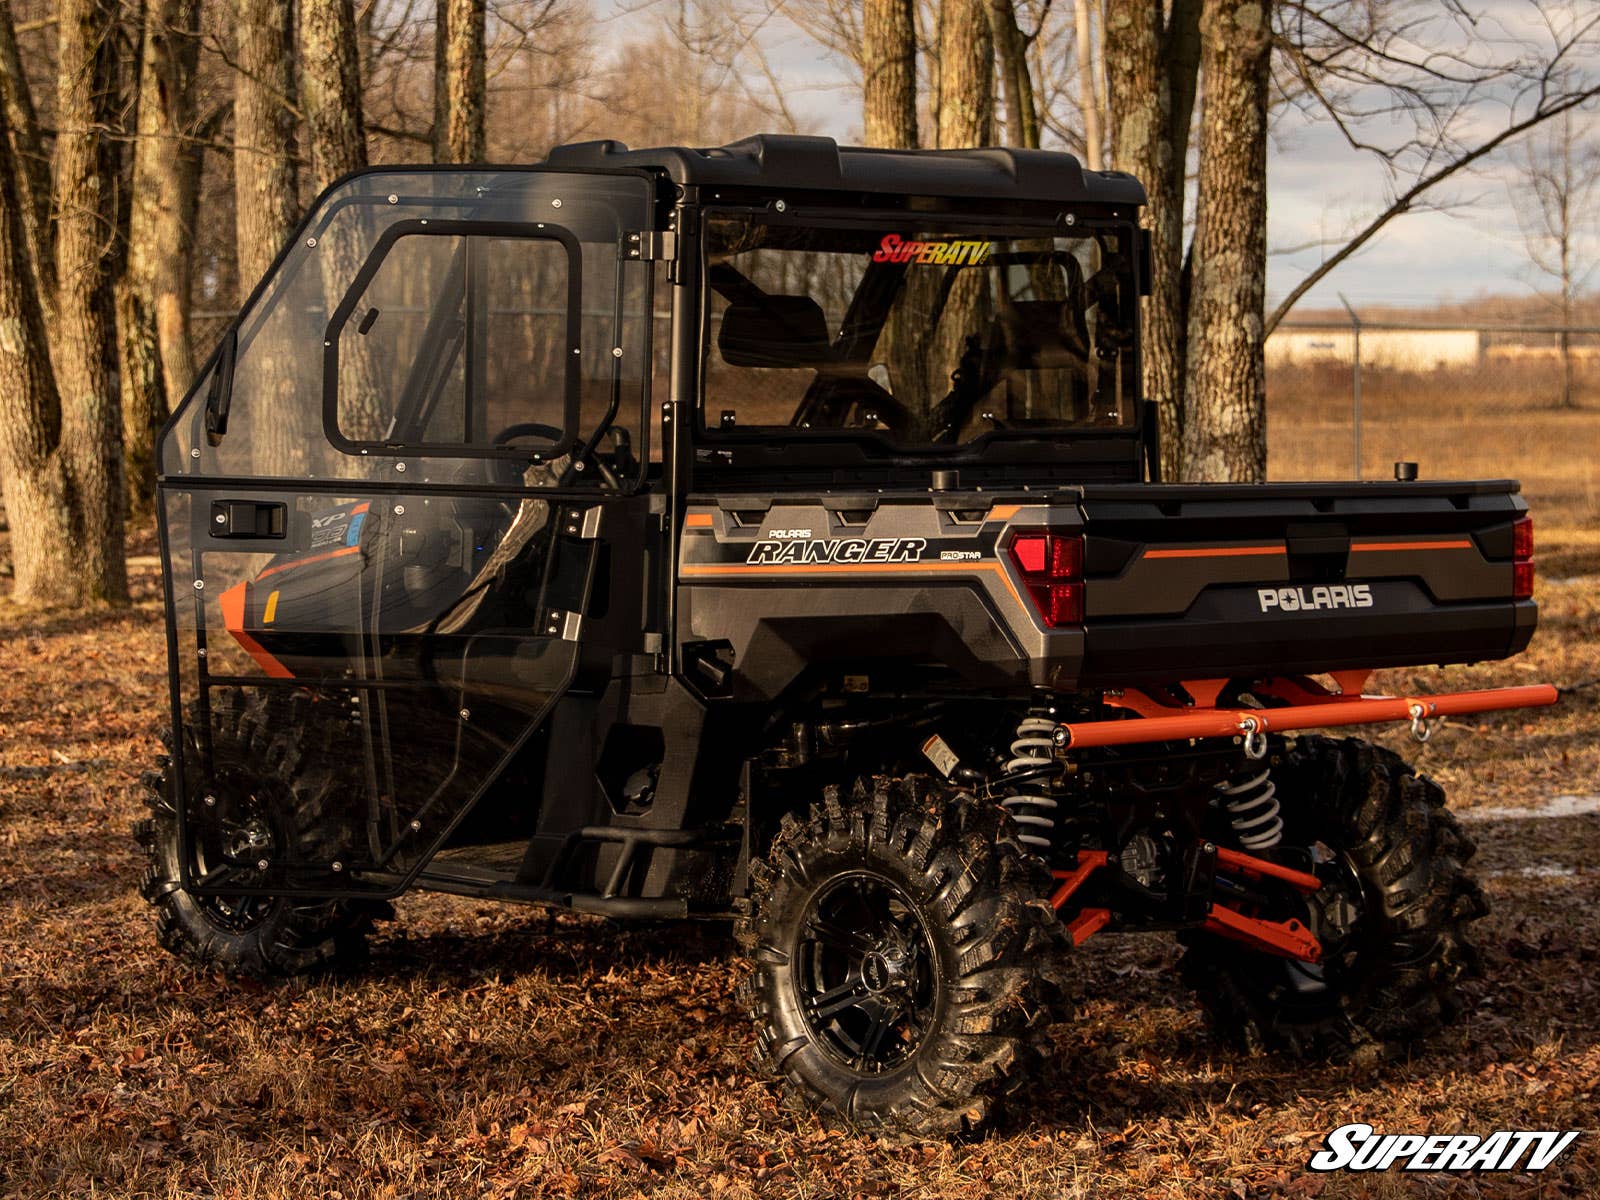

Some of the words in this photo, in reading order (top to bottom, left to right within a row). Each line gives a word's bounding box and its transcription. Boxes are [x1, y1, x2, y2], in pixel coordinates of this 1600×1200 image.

[873, 234, 990, 265] SUPERATV
[768, 529, 812, 539] POLARIS
[746, 538, 927, 564] RANGER
[940, 551, 982, 561] PROSTAR
[1257, 584, 1373, 613] POLARIS
